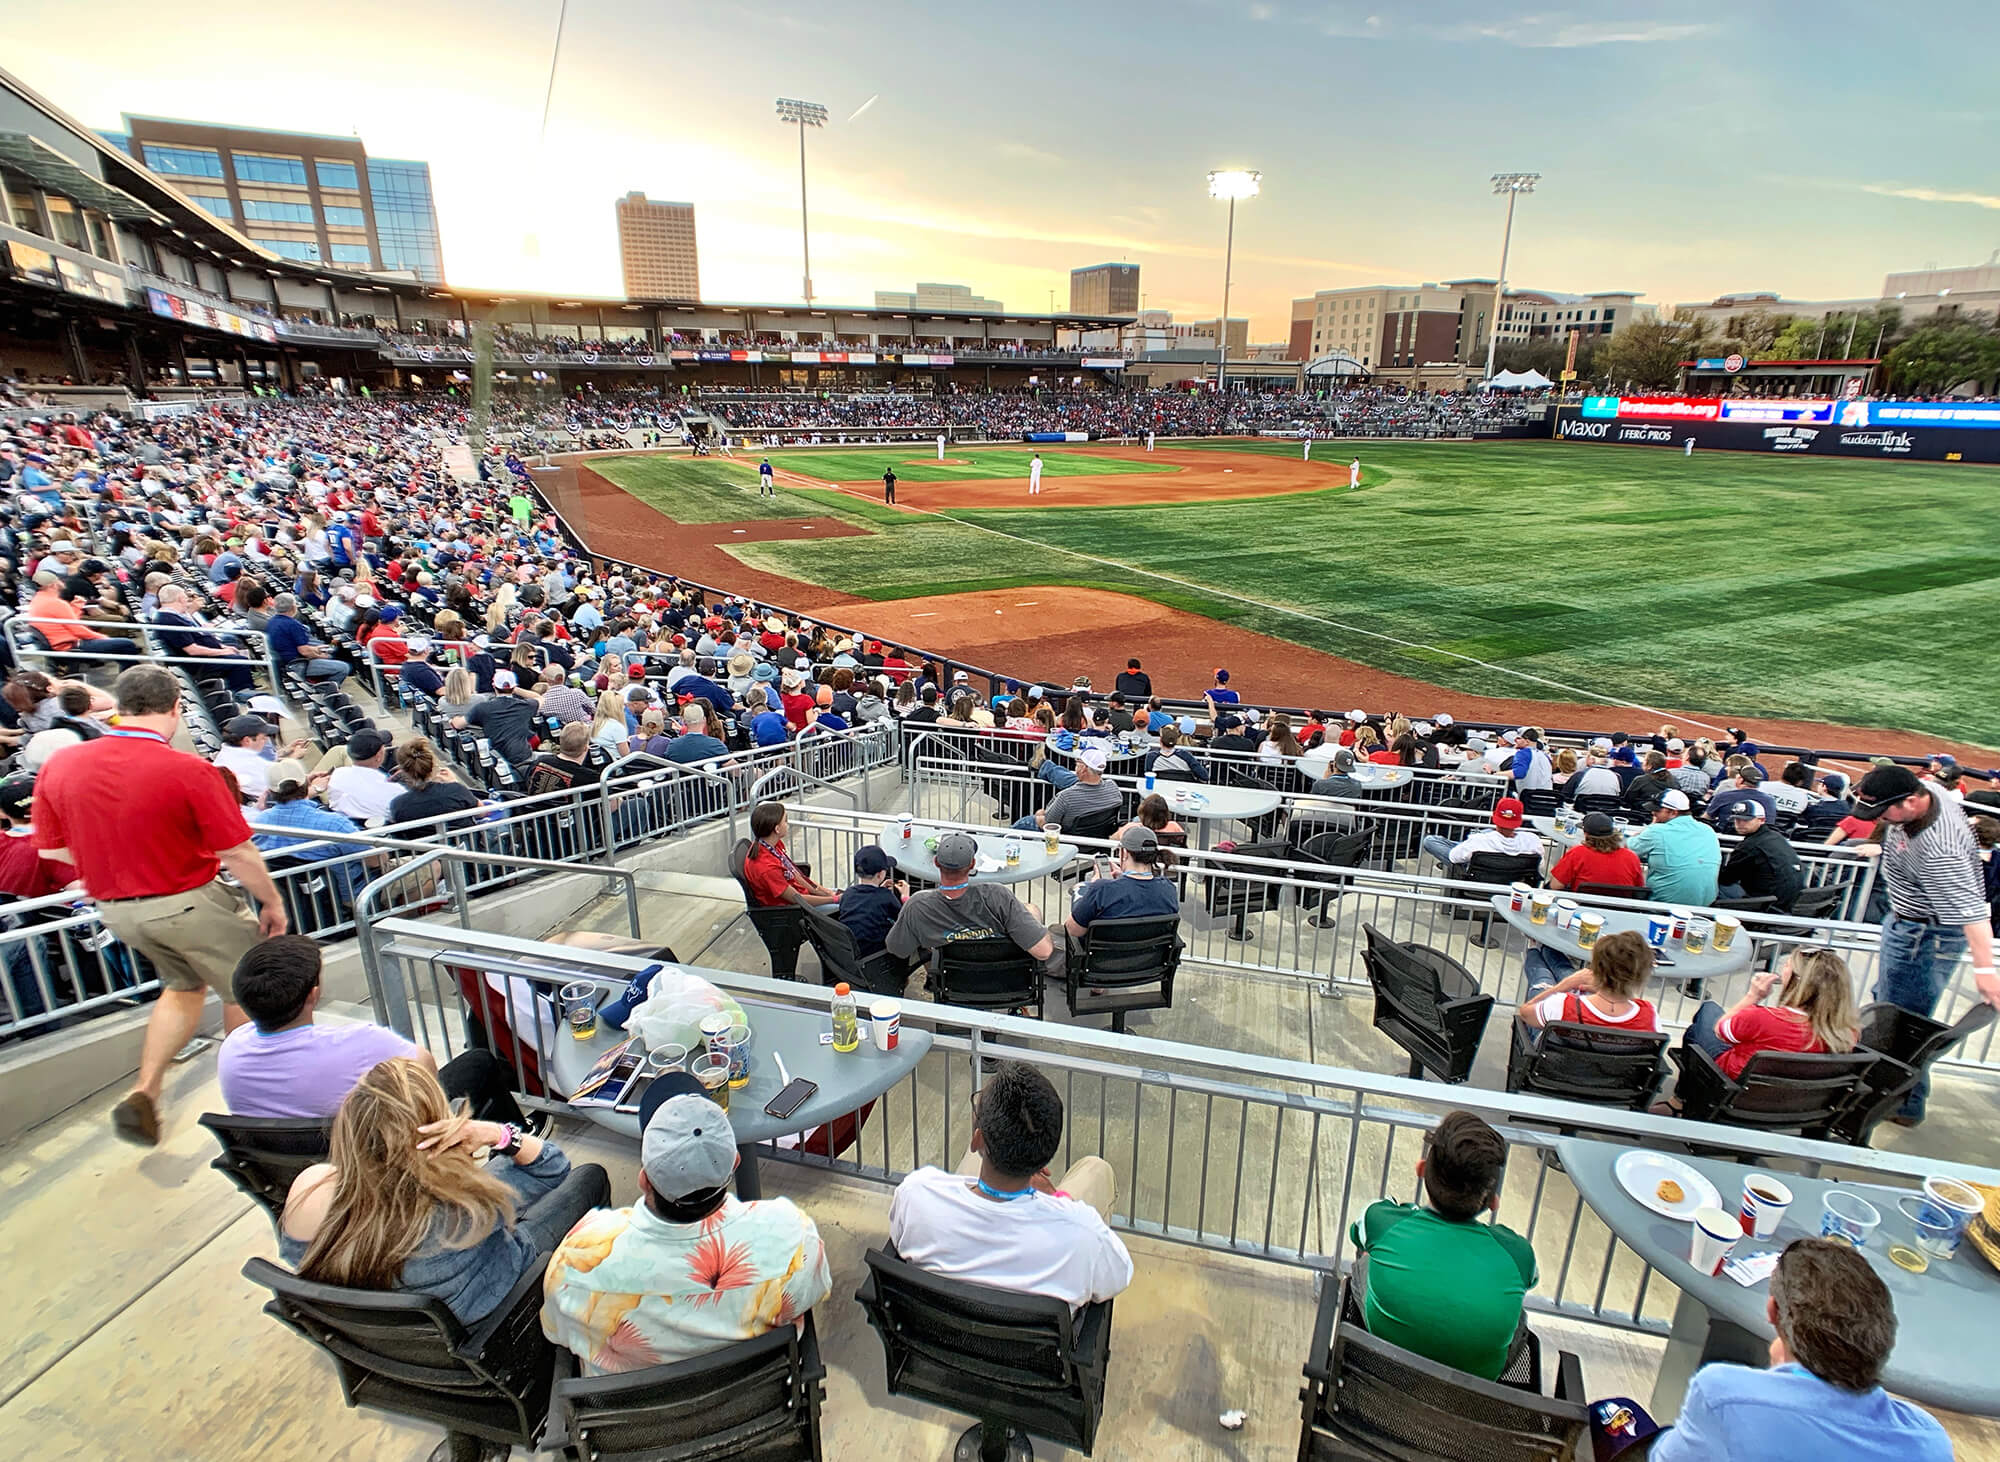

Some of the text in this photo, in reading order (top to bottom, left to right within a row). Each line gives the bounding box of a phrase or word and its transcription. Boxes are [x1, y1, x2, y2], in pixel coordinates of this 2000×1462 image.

[1560, 420, 1611, 437] Maxor
[1625, 430, 1647, 440] FERG
[1647, 430, 1672, 441] PROS
[1841, 431, 1915, 446] suddenlink
[1768, 793, 1799, 807] TAFF
